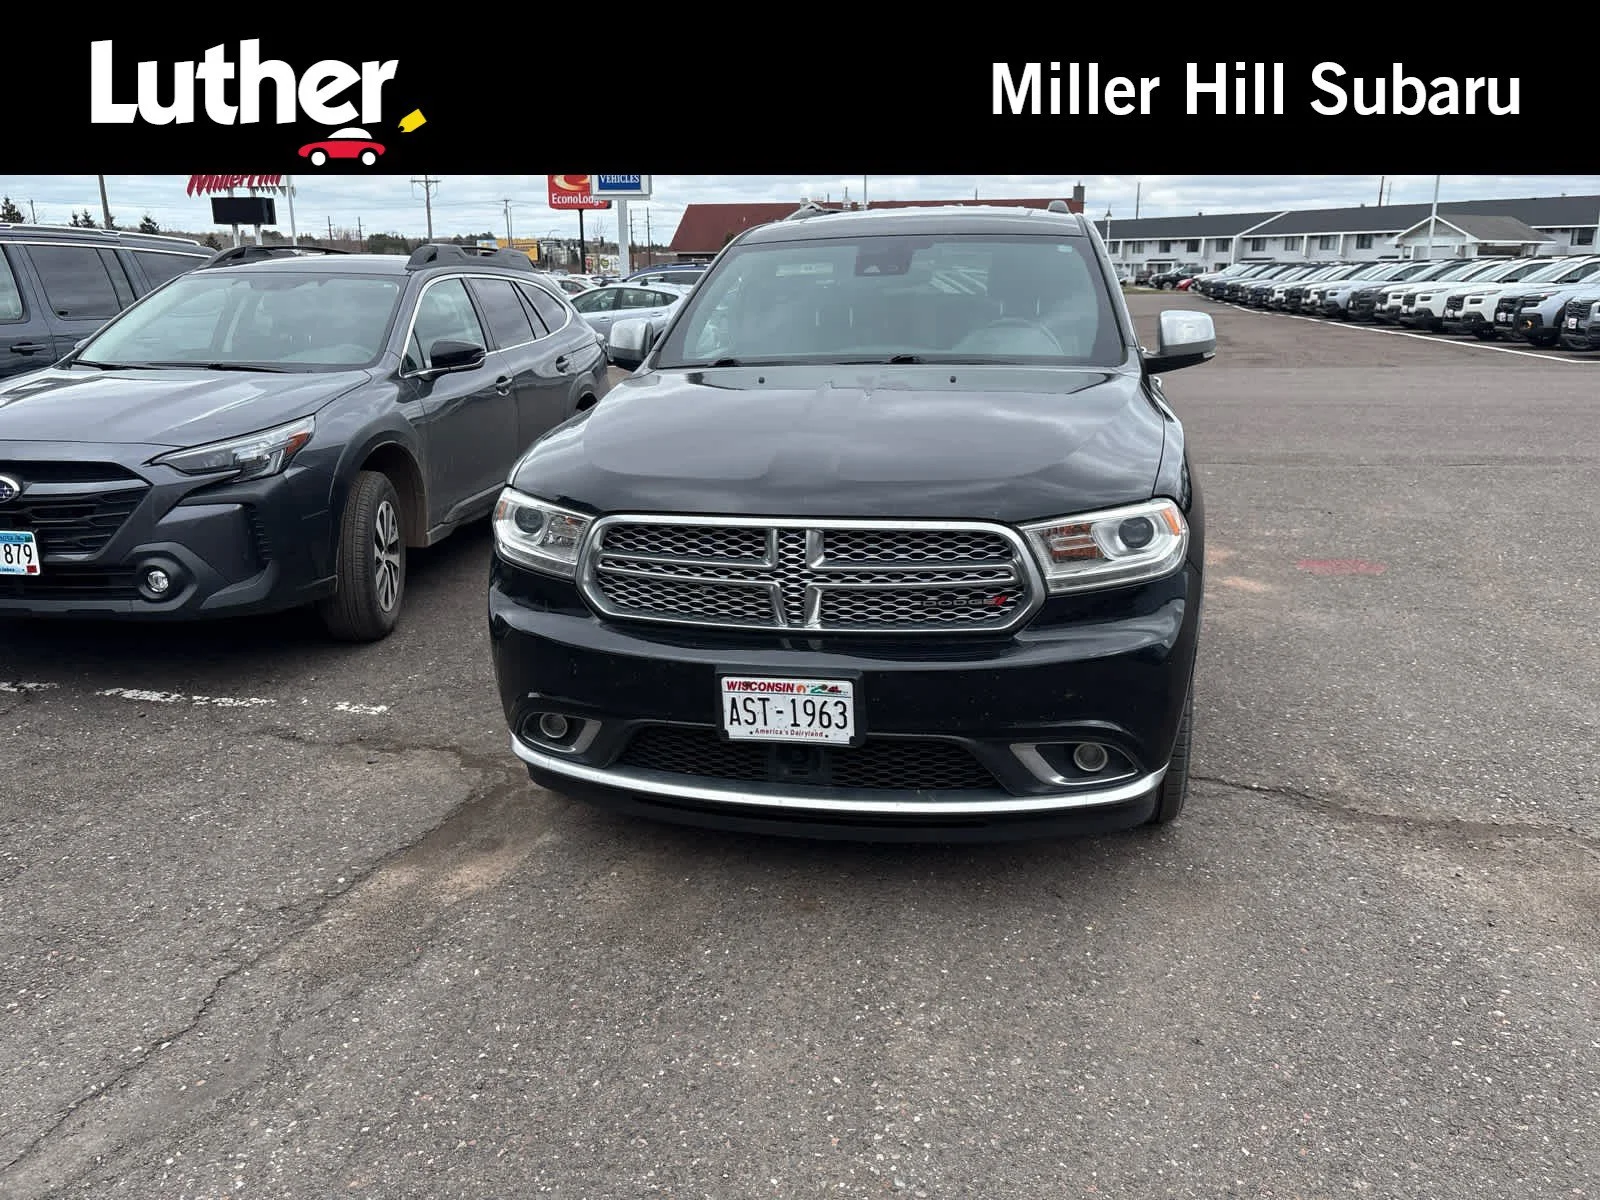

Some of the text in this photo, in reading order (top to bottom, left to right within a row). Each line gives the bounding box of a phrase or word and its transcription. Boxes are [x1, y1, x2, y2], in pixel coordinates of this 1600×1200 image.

[600, 174, 640, 184] VEHICLES
[4, 544, 32, 564] 879
[922, 599, 995, 607] DODGE
[726, 681, 795, 693] WISCONSIN
[729, 697, 848, 729] AST-1963
[755, 728, 824, 738] America's Dairyland
